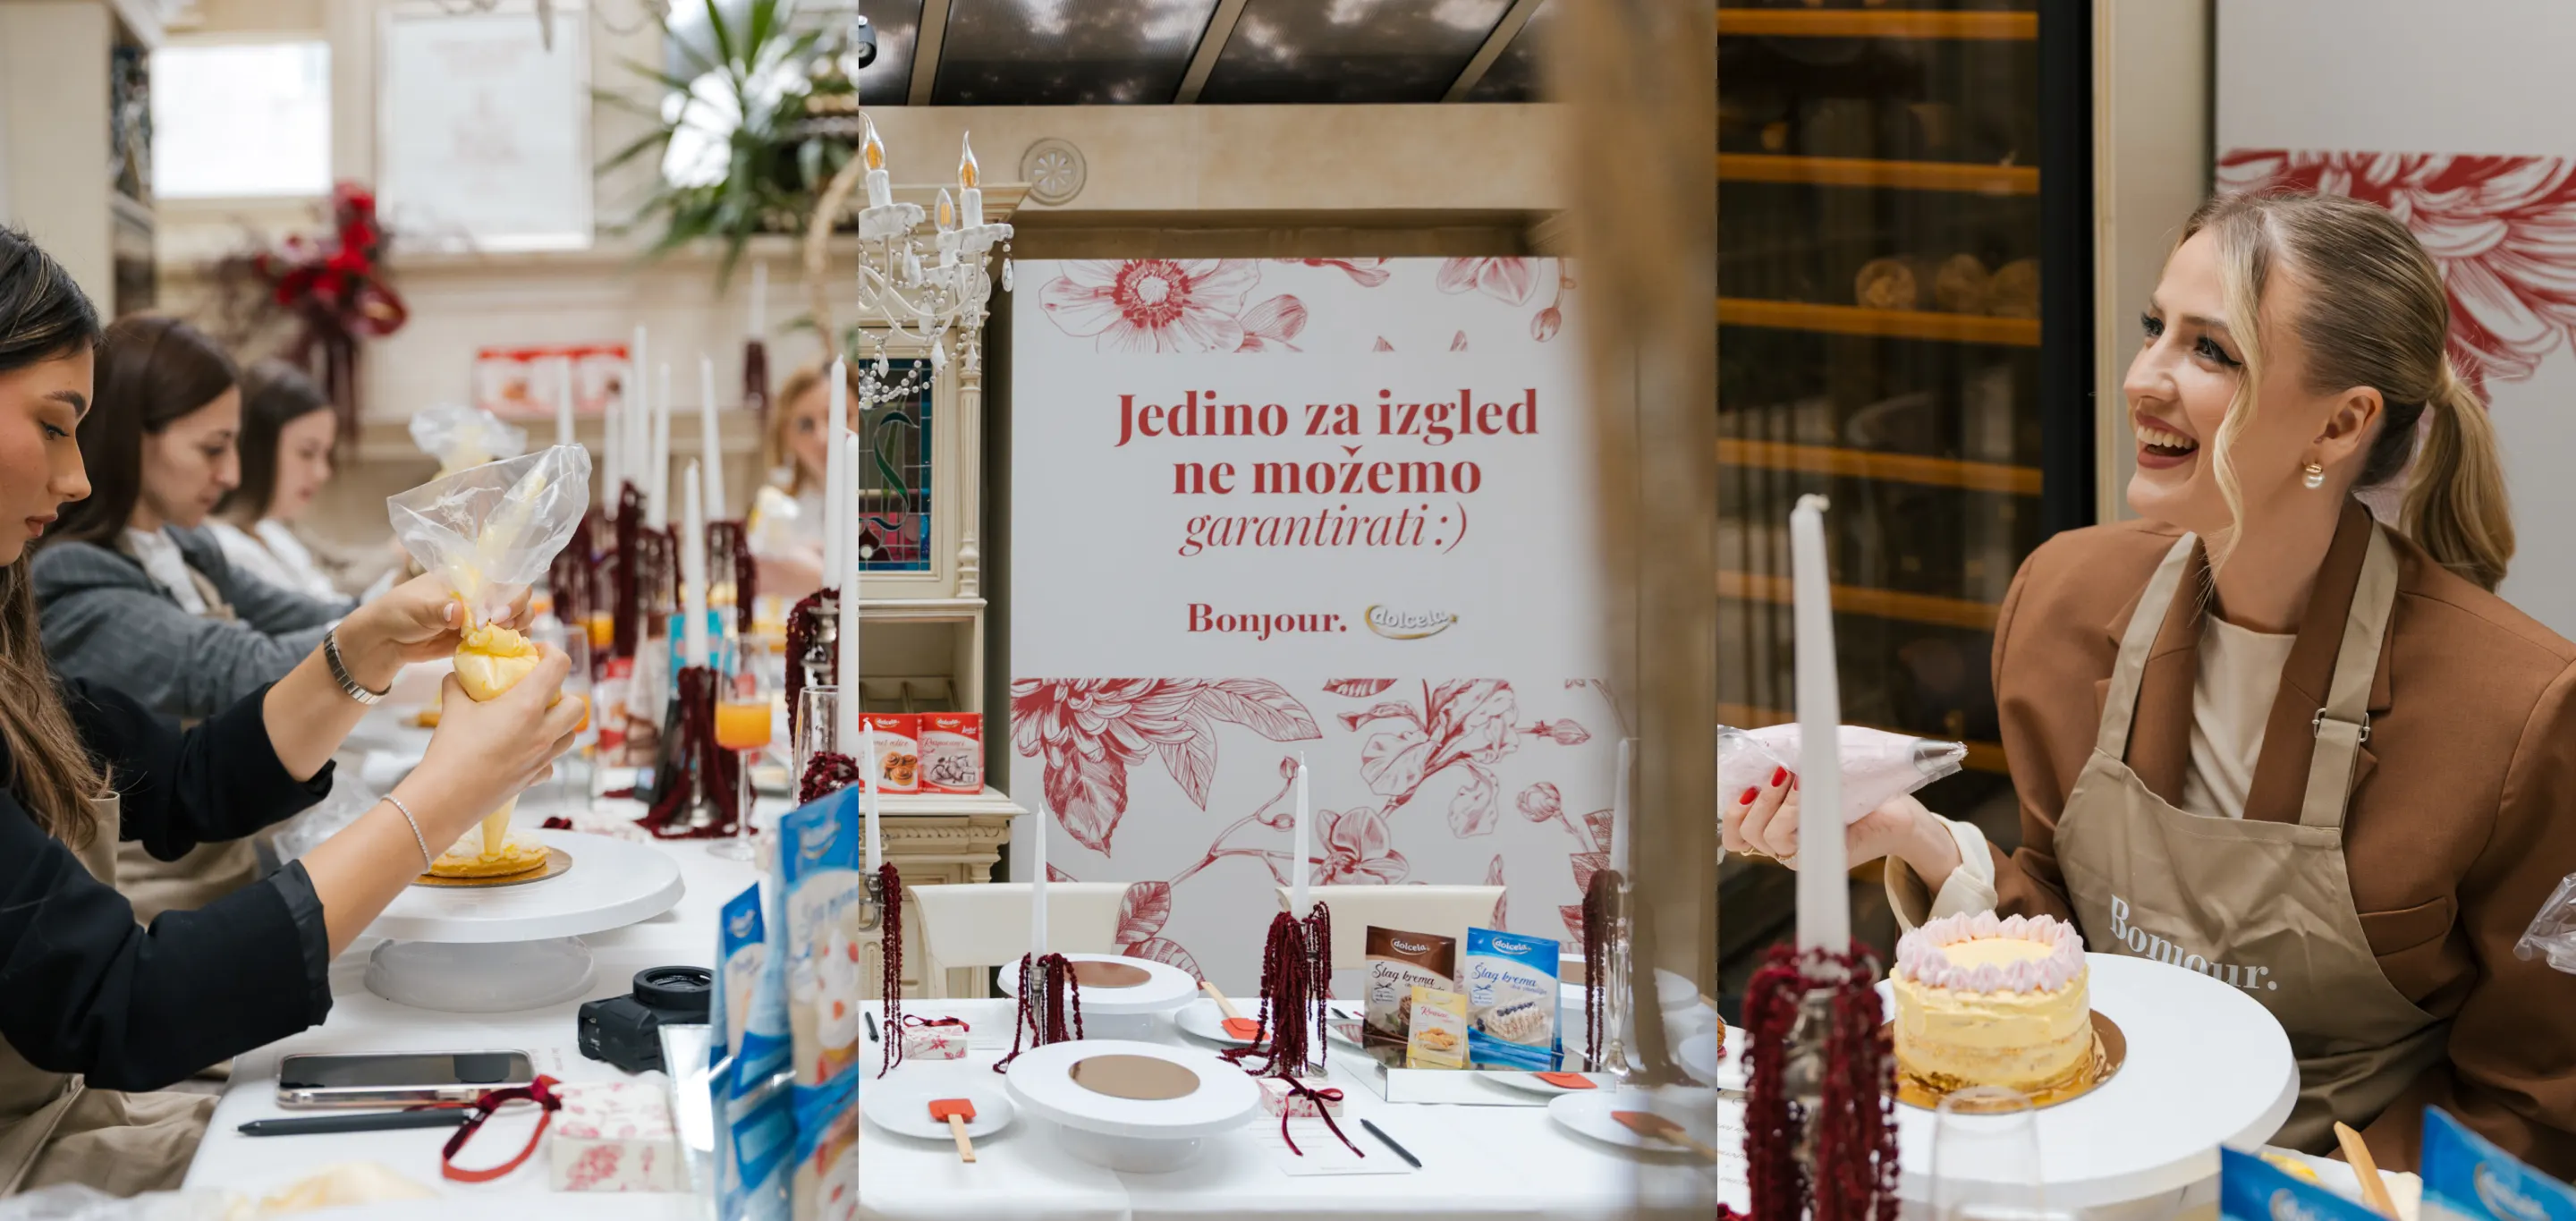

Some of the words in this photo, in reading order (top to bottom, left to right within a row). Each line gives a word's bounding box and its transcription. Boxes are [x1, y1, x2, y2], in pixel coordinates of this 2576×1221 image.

[1114, 390, 1288, 447] Jedino
[1305, 403, 1360, 436] za
[1377, 388, 1538, 445] izgled
[1173, 461, 1235, 495] ne
[1252, 445, 1481, 495] možemo
[1178, 504, 1428, 556] garantirati
[1187, 603, 1347, 641] Bonjour.
[1393, 940, 1427, 952] dolcela
[1495, 939, 1528, 951] dolcela
[1402, 970, 1436, 986] krema
[1502, 971, 1538, 987] krema
